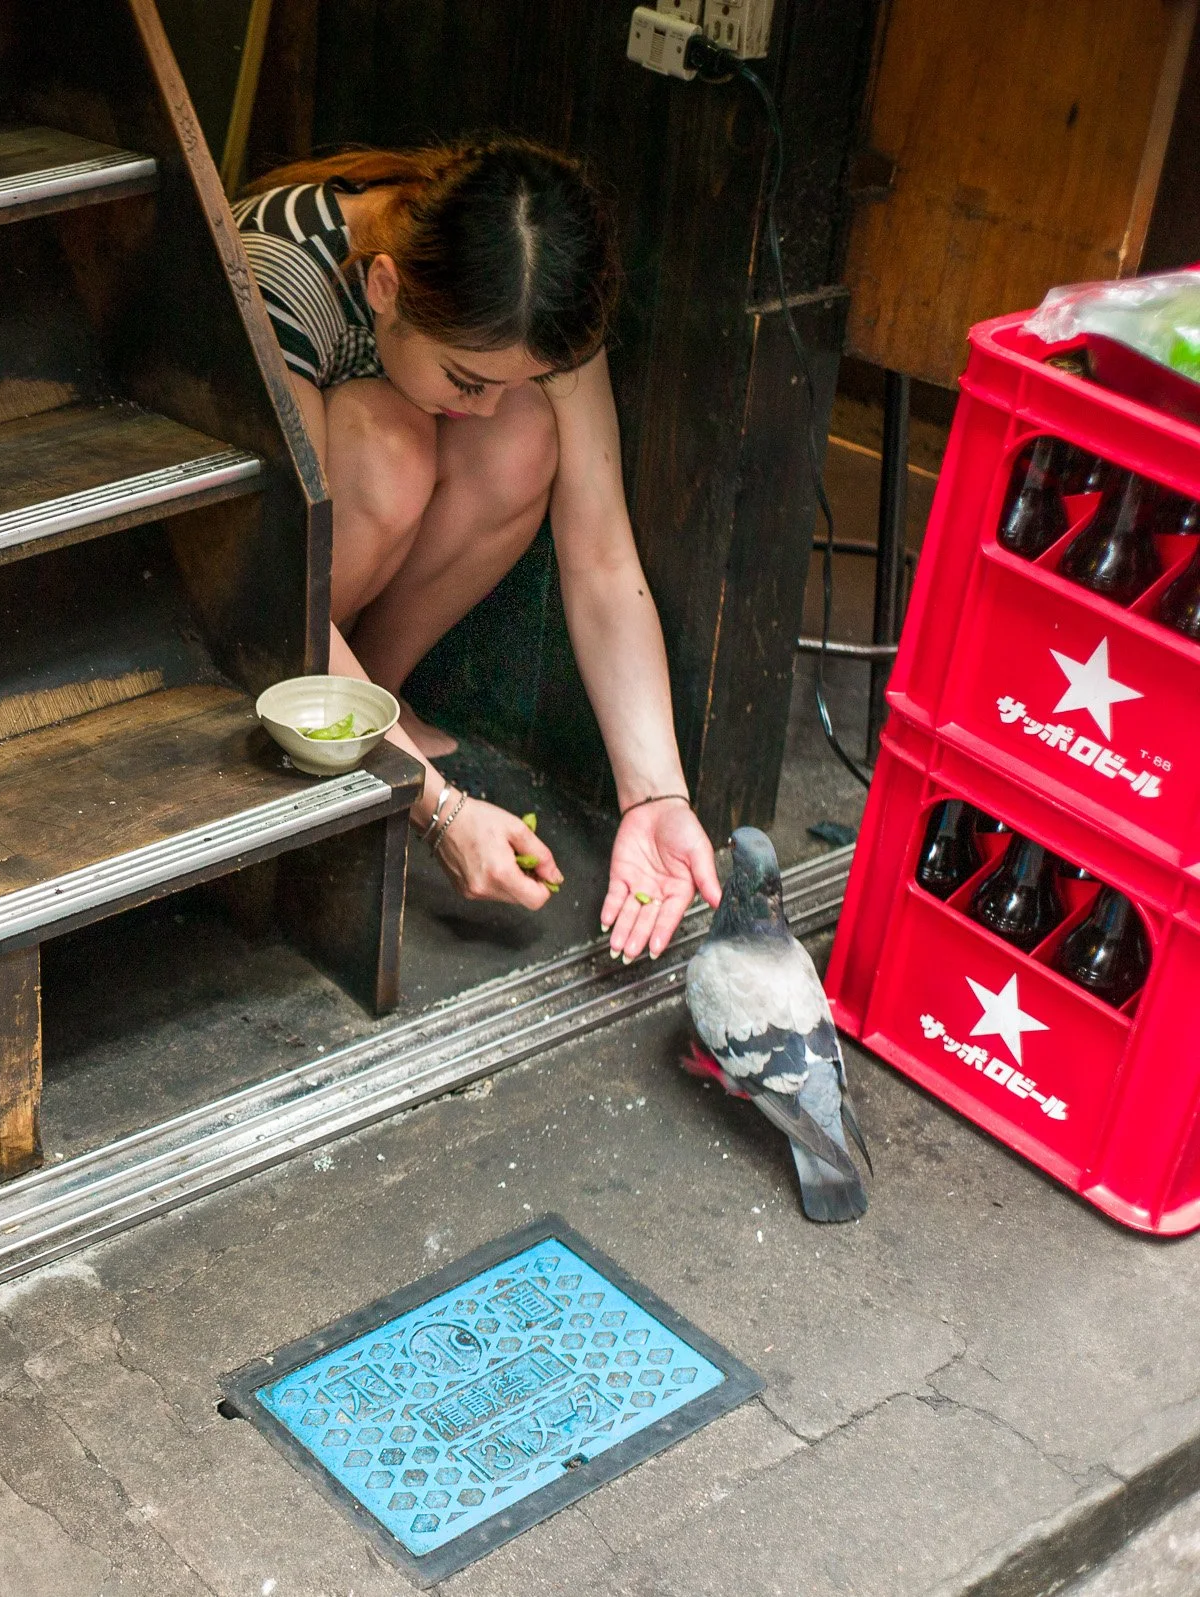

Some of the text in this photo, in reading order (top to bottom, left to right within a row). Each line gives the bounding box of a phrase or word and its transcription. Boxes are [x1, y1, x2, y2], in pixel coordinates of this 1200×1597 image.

[996, 695, 1162, 799] サッポロビール
[919, 1013, 1069, 1121] サッポロビール
